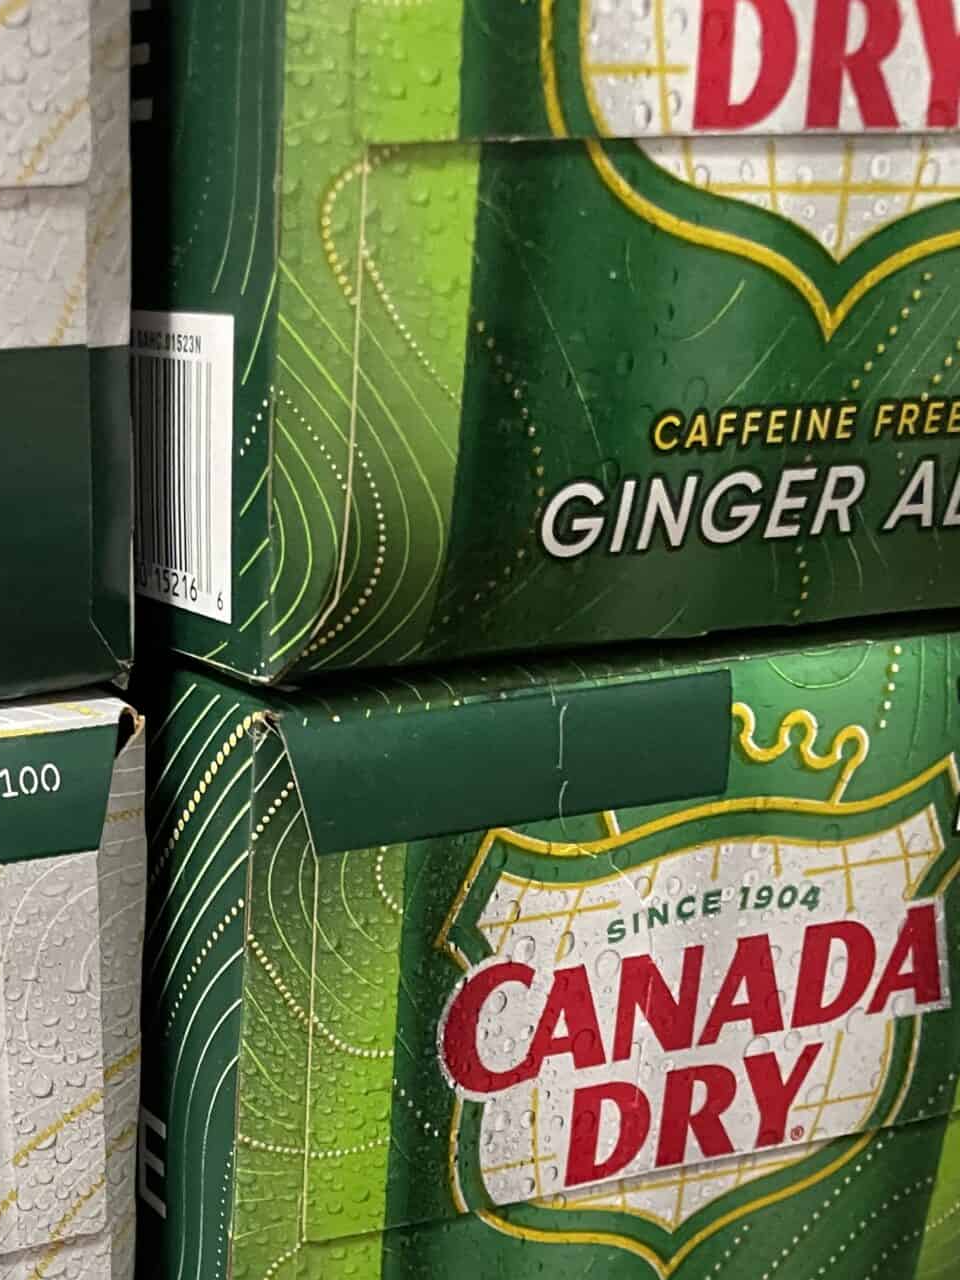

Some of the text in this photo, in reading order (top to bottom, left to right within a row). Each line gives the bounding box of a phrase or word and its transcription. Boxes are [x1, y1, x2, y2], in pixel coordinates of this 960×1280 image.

[653, 405, 857, 451] CAFFEINE
[540, 464, 866, 559] GINGER
[217, 592, 224, 611] 6
[606, 884, 823, 946] SINCE 1904
[441, 903, 945, 1094] CANADA
[562, 1041, 825, 1188] DRY
